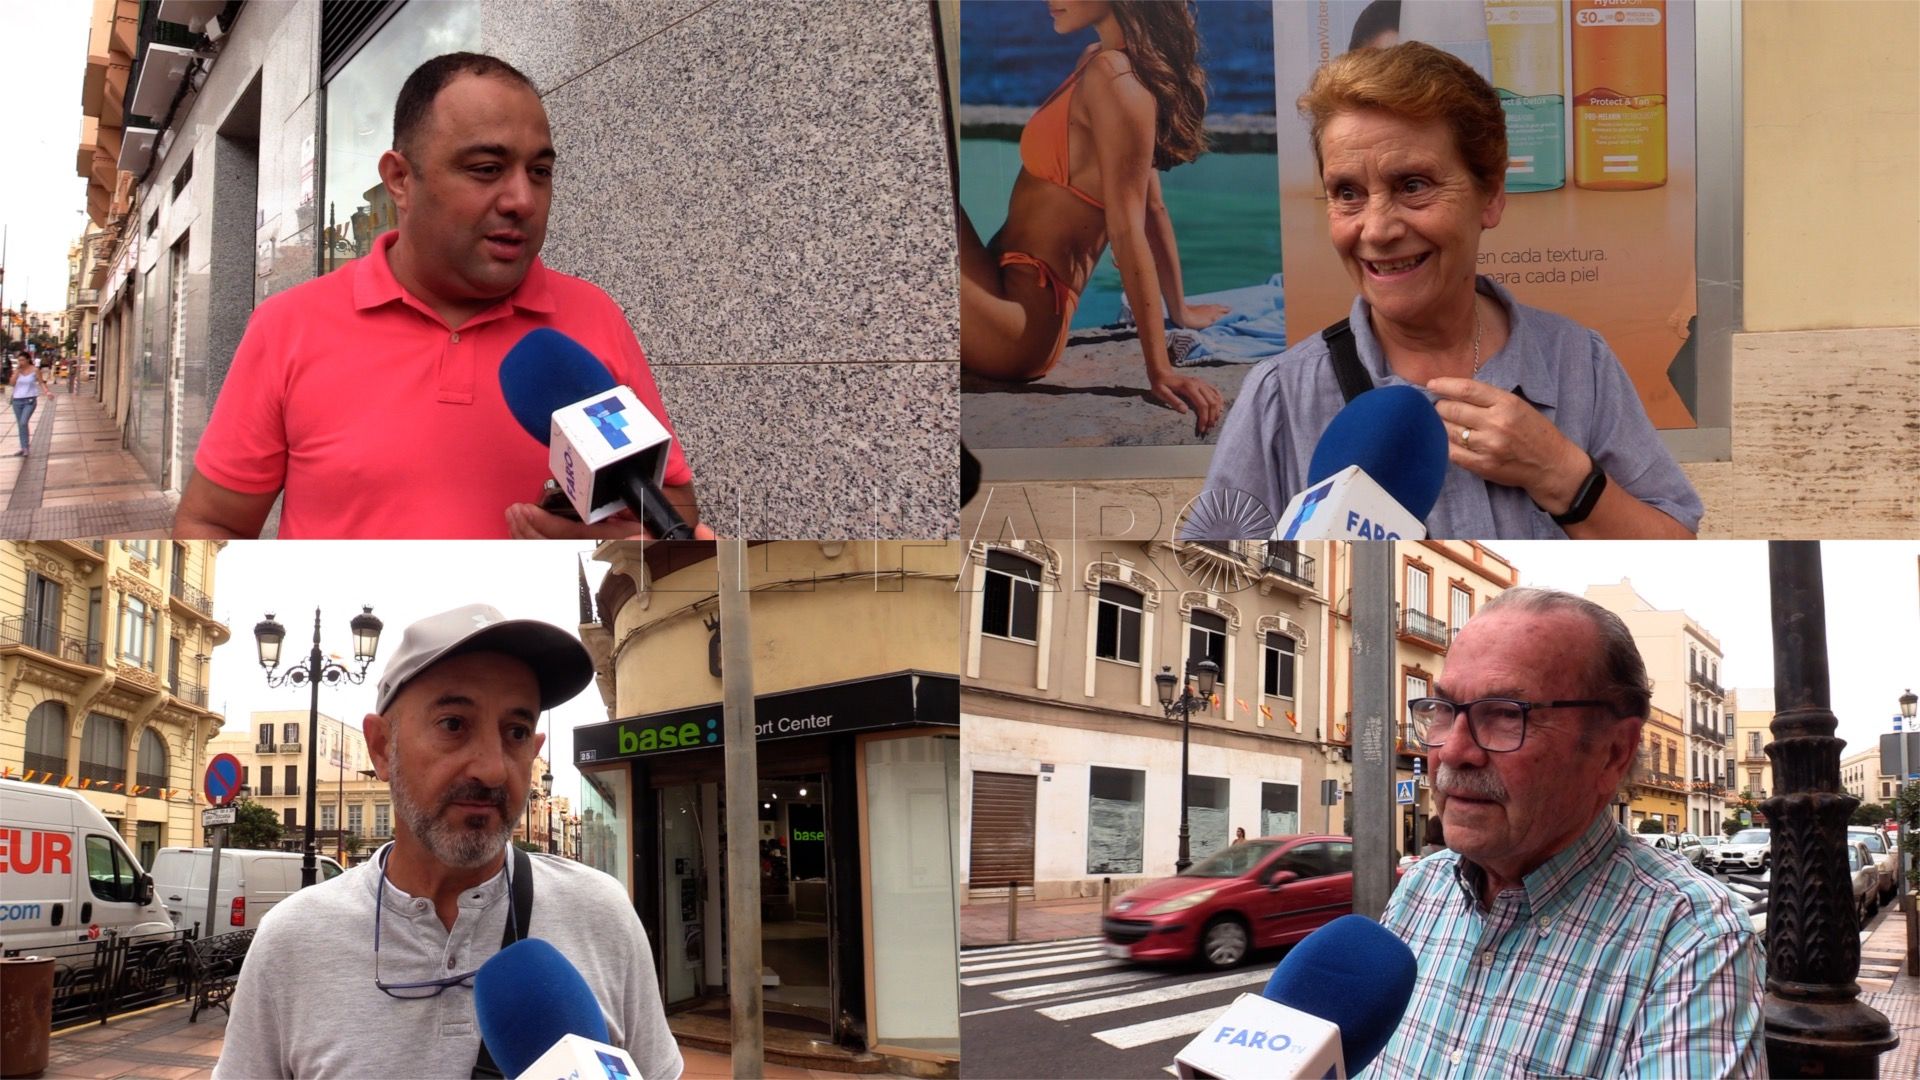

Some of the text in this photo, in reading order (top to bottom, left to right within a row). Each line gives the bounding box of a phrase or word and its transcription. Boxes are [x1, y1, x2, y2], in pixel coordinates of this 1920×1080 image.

[1590, 97, 1624, 106] Protect
[1476, 247, 1607, 265] en cada textura.
[1525, 267, 1566, 284] cada
[1570, 266, 1599, 285] piel
[564, 450, 578, 502] FARO
[754, 720, 774, 736] ort
[778, 714, 833, 732] Center
[793, 828, 825, 841] base
[1214, 1026, 1292, 1052] FARO
